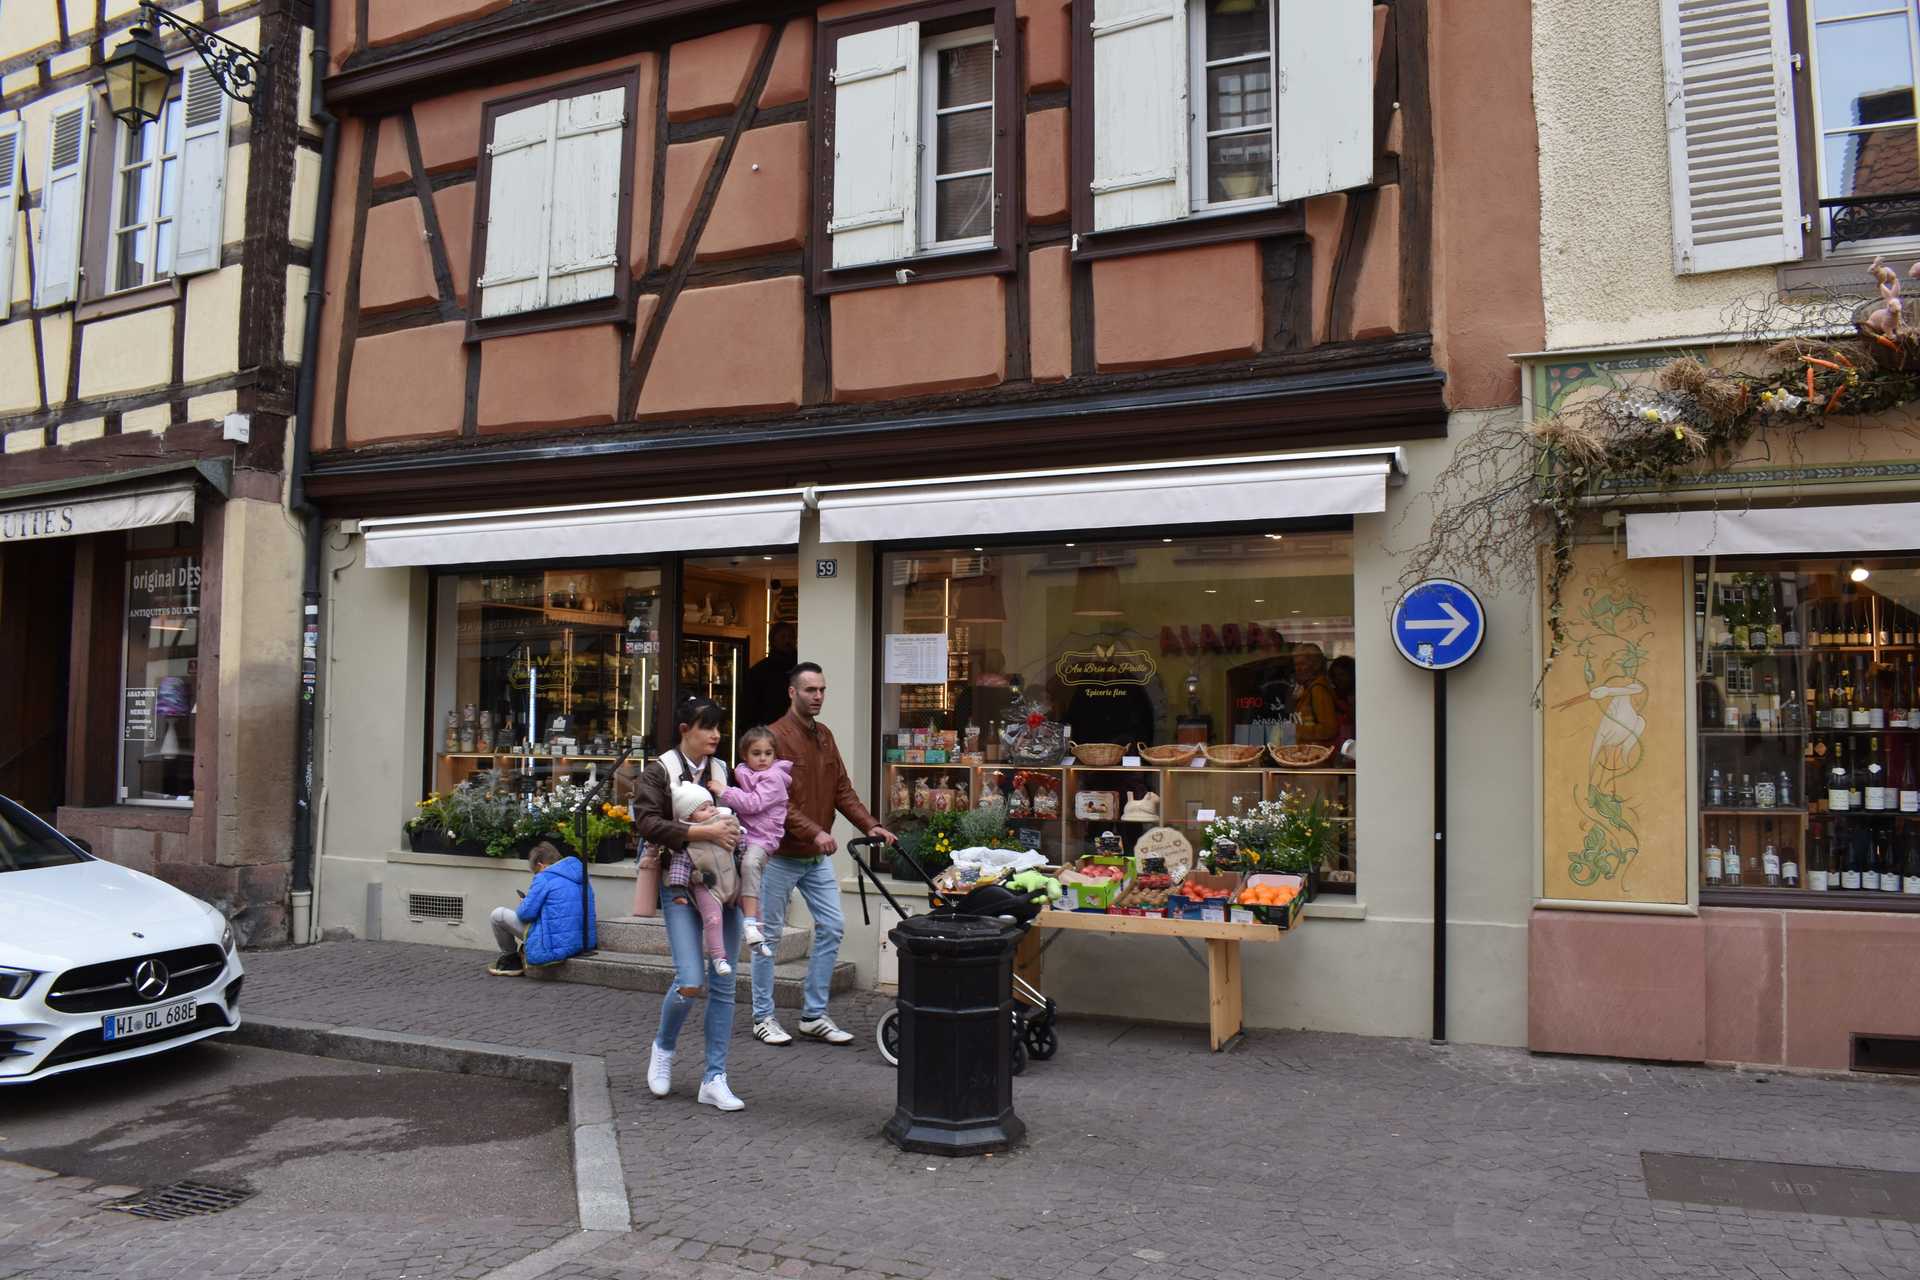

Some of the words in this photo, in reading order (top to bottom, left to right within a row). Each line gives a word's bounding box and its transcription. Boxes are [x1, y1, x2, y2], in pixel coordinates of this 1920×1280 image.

[133, 568, 176, 593] original
[819, 561, 834, 576] 59
[145, 1011, 162, 1029] QL
[166, 1002, 195, 1025] 688E
